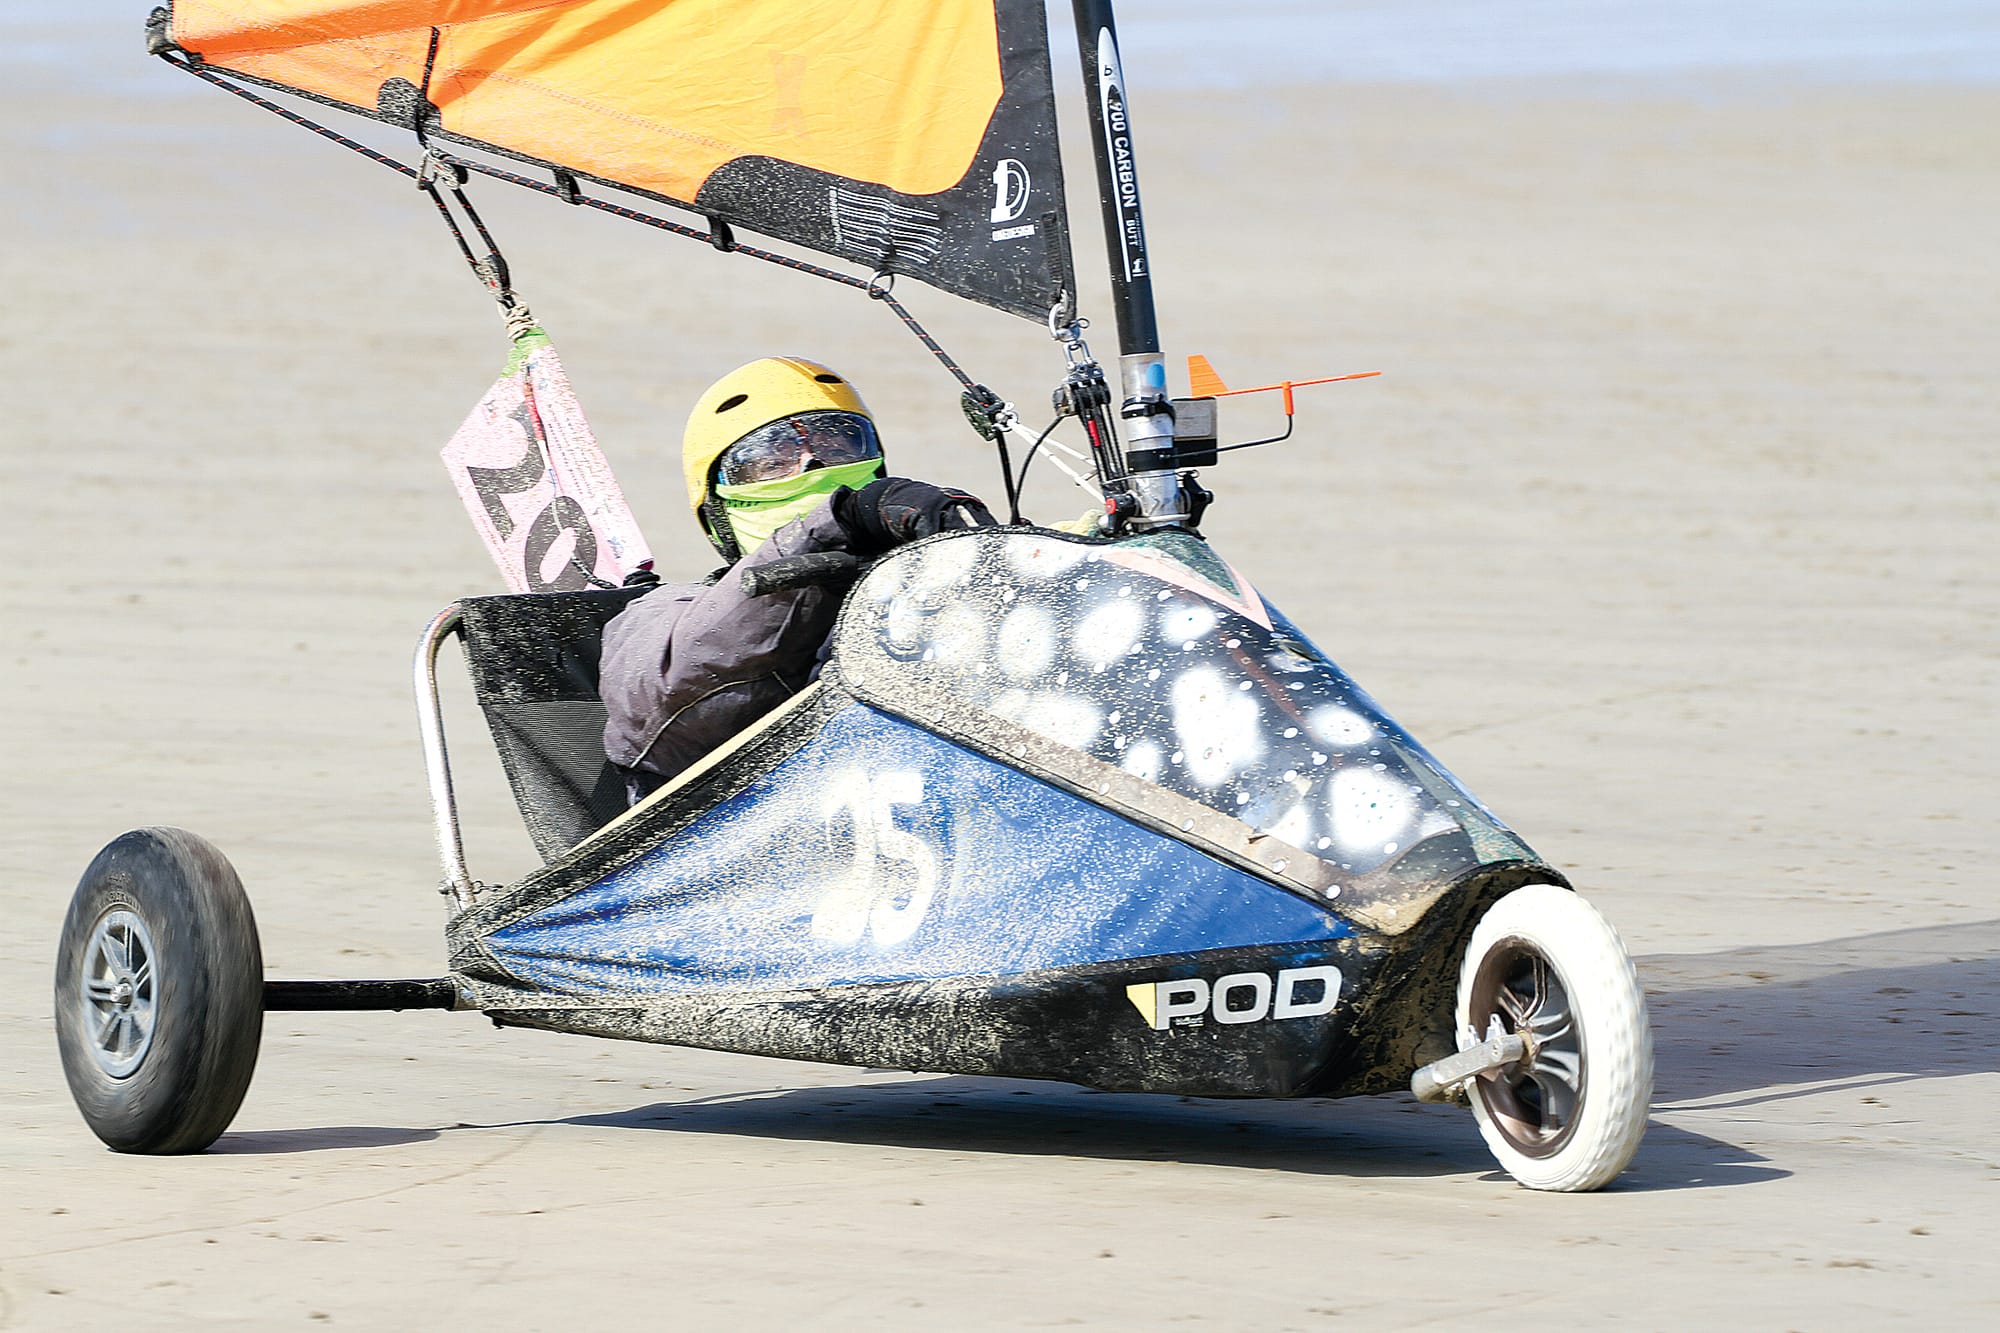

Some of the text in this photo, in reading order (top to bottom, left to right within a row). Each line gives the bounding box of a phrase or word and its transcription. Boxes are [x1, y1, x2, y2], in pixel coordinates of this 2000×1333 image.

[1114, 137, 1137, 208] CARBON
[1125, 219, 1139, 248] BUTT
[1155, 965, 1342, 1030] POD
